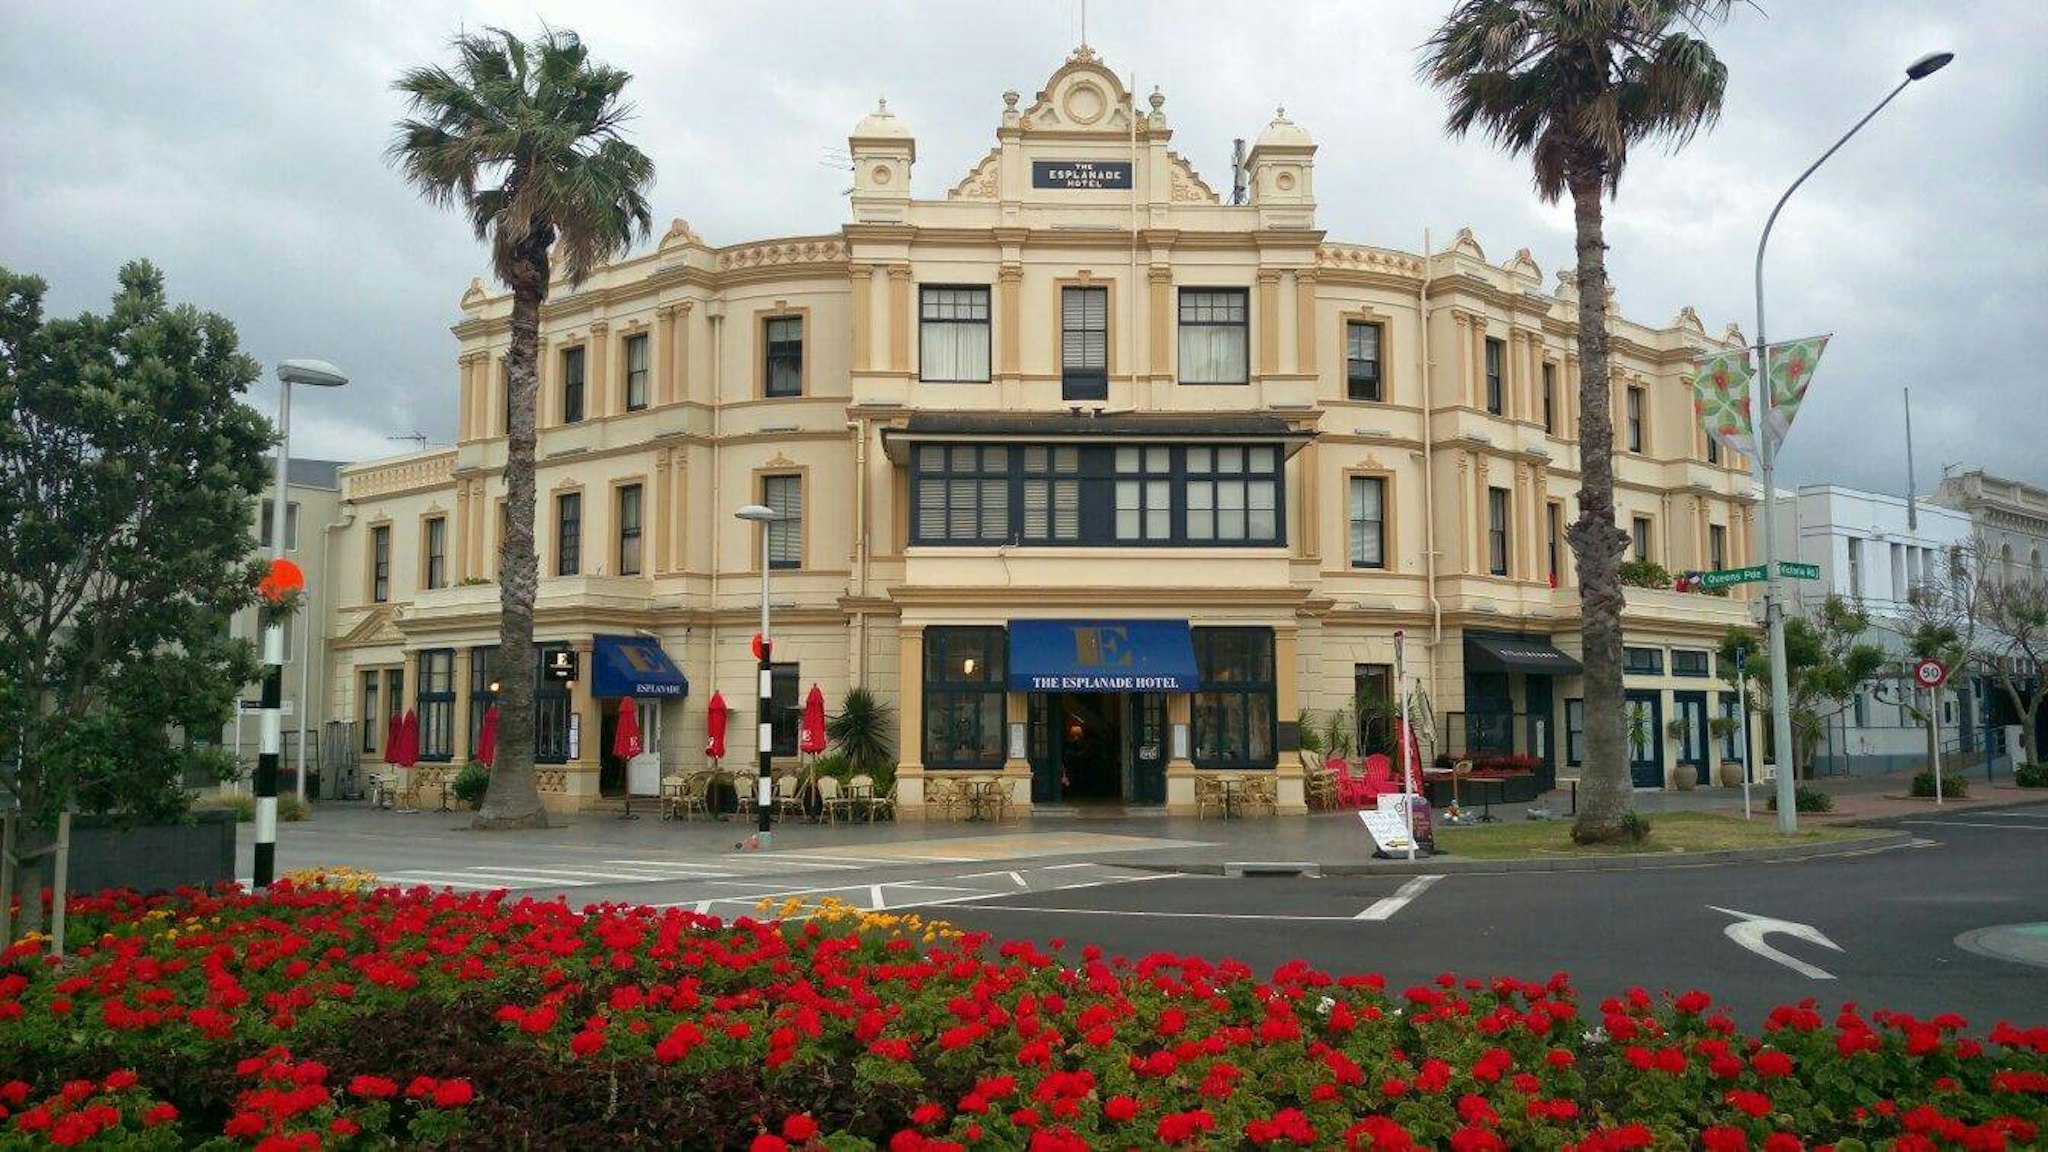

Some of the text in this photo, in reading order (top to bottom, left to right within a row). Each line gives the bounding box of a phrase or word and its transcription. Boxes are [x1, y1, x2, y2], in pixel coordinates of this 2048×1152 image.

[1074, 163, 1094, 171] THE
[1048, 170, 1122, 180] ESPLANADE
[1066, 179, 1103, 188] HOTEL
[1070, 626, 1133, 667] E
[556, 652, 568, 665] E
[1922, 667, 1939, 679] 50
[1032, 676, 1179, 689] THE ESPLANADE HOTEL
[635, 683, 682, 695] ESPLANADE
